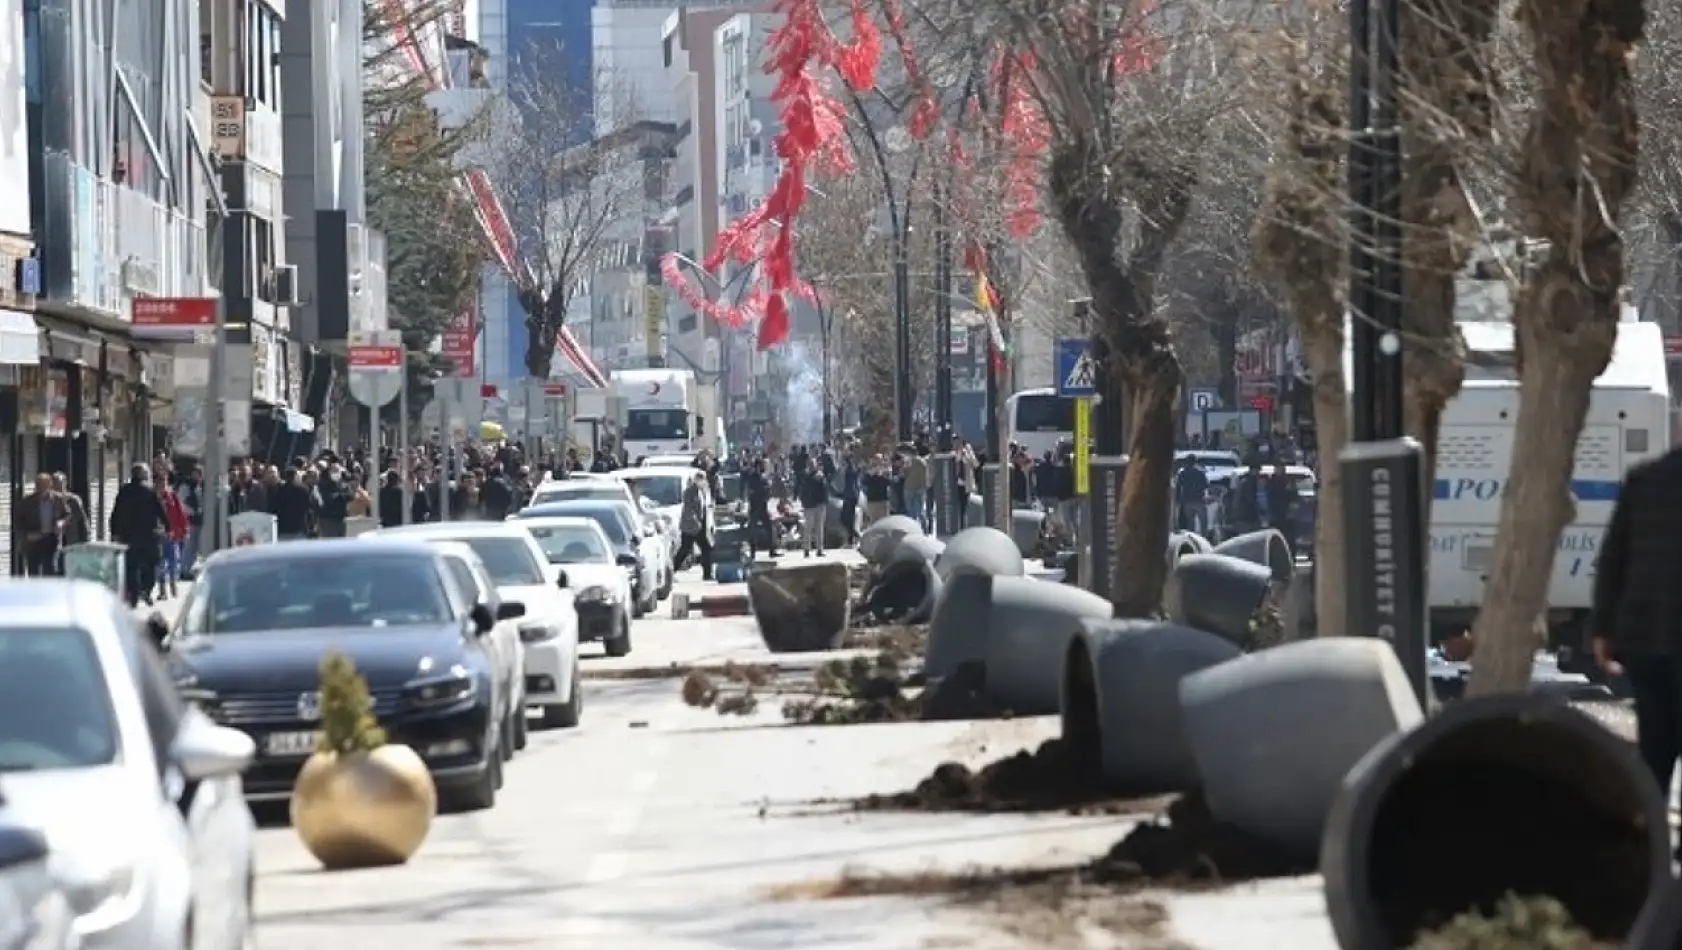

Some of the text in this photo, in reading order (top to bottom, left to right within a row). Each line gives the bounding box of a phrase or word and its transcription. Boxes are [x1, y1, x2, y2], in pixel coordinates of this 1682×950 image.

[1454, 478, 1502, 500] PO
[1559, 531, 1596, 552] OLİS
[1372, 467, 1397, 641] CUMHURİYET C
